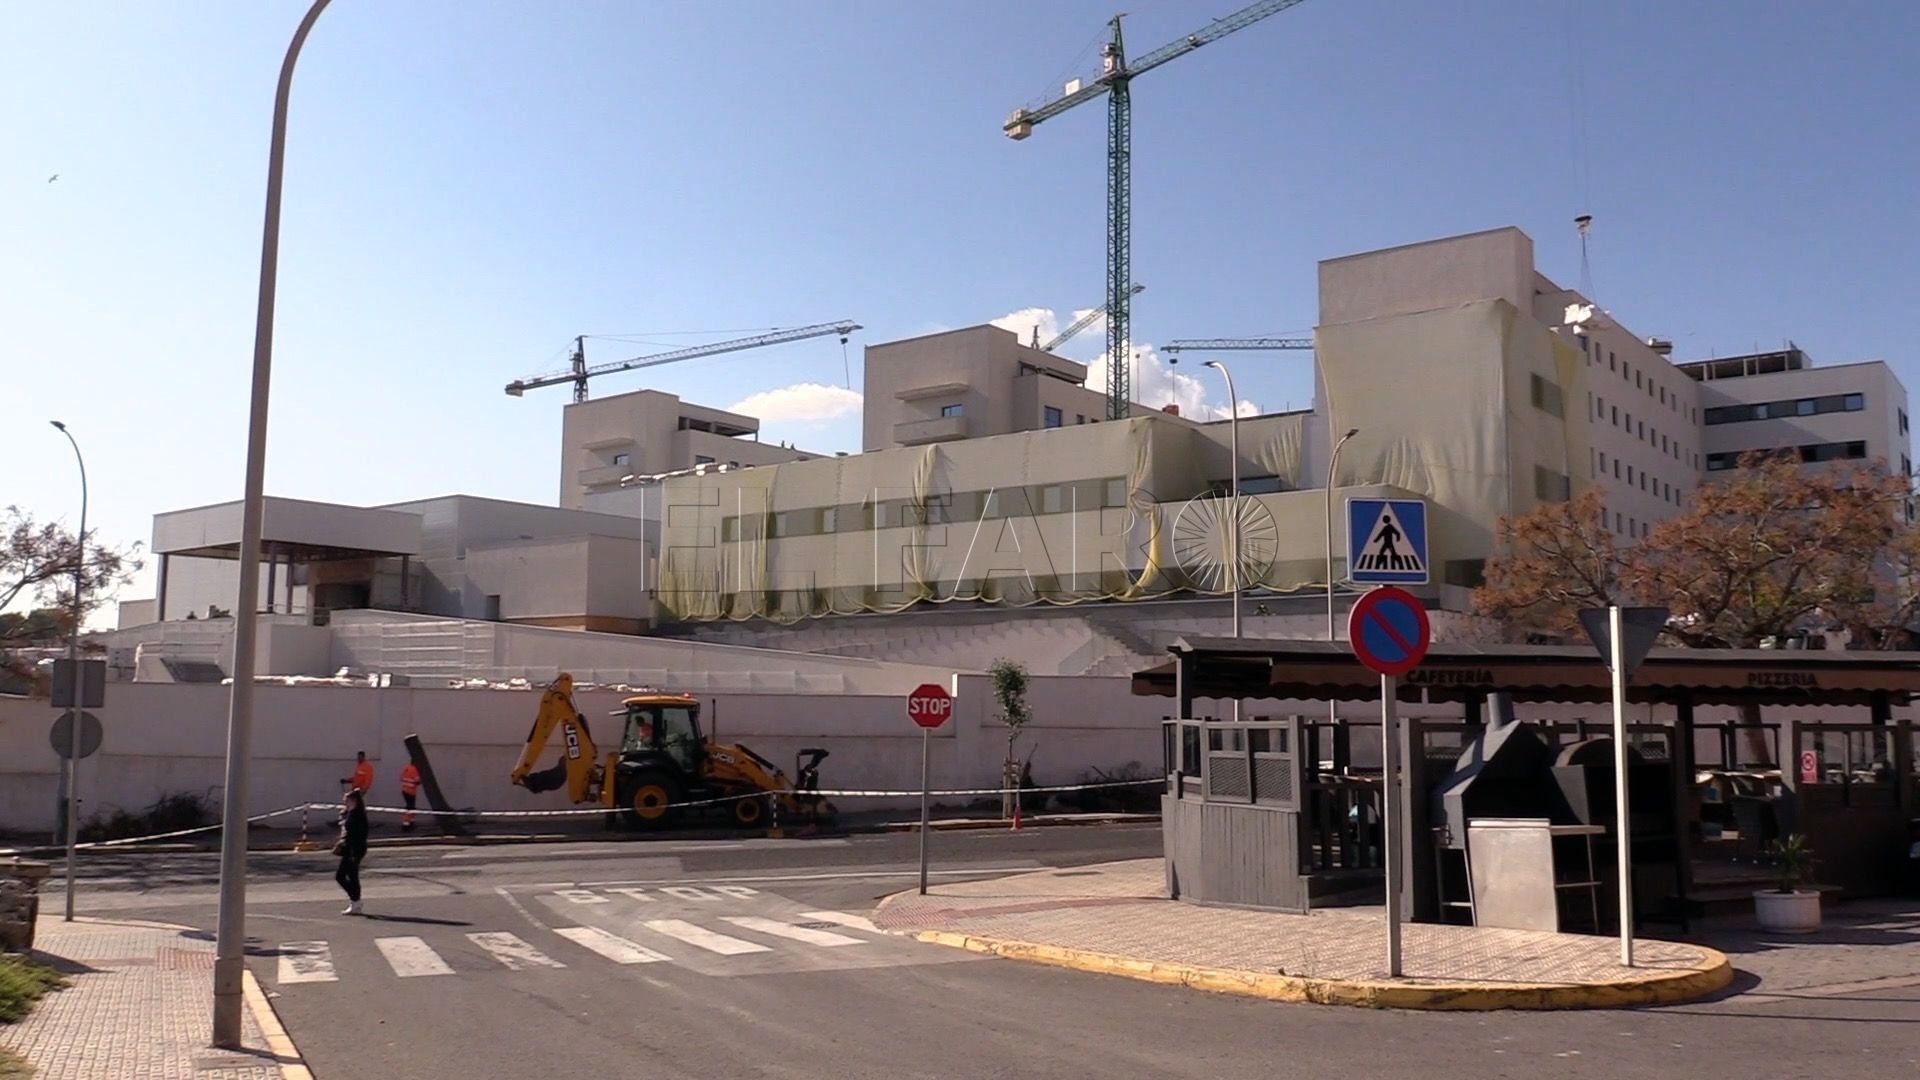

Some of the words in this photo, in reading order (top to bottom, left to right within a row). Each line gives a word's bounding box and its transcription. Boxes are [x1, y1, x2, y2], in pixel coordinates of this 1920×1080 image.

[910, 697, 951, 715] STOP
[564, 724, 580, 759] JCB
[712, 751, 736, 764] JCB
[553, 885, 760, 904] STOP
